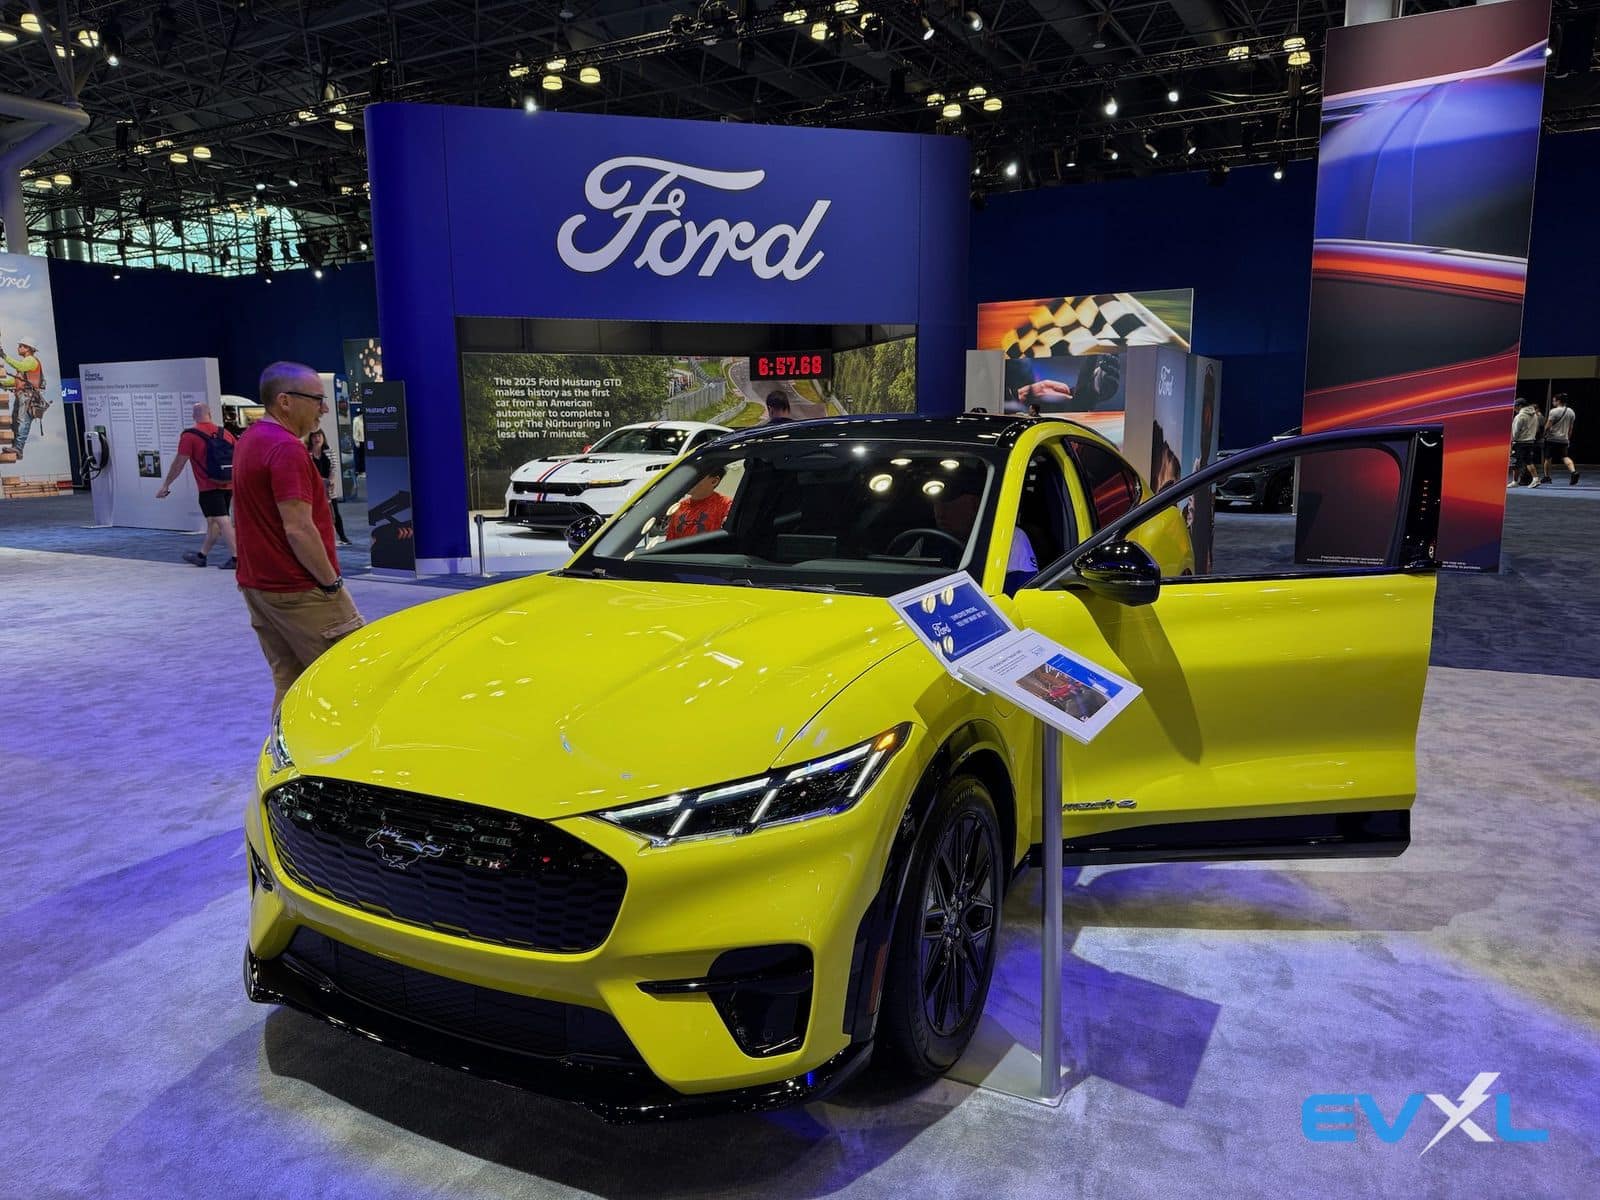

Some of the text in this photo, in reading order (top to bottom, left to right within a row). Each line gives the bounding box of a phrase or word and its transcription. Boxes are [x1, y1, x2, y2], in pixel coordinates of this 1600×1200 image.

[557, 156, 832, 281] Ford
[758, 355, 822, 376] 6:57.68
[494, 377, 622, 388] The 2025 Ford Mustang GTD
[1158, 366, 1175, 397] Ford
[495, 387, 610, 398] makes history as the first
[512, 399, 534, 407] from
[536, 400, 548, 408] an
[550, 399, 593, 408] American
[496, 409, 546, 418] automaker
[548, 410, 558, 418] to
[560, 409, 603, 419] complete
[496, 419, 611, 430] lap of The Nürburgring in
[497, 430, 517, 439] less
[518, 430, 540, 439] than
[541, 430, 547, 438] 7
